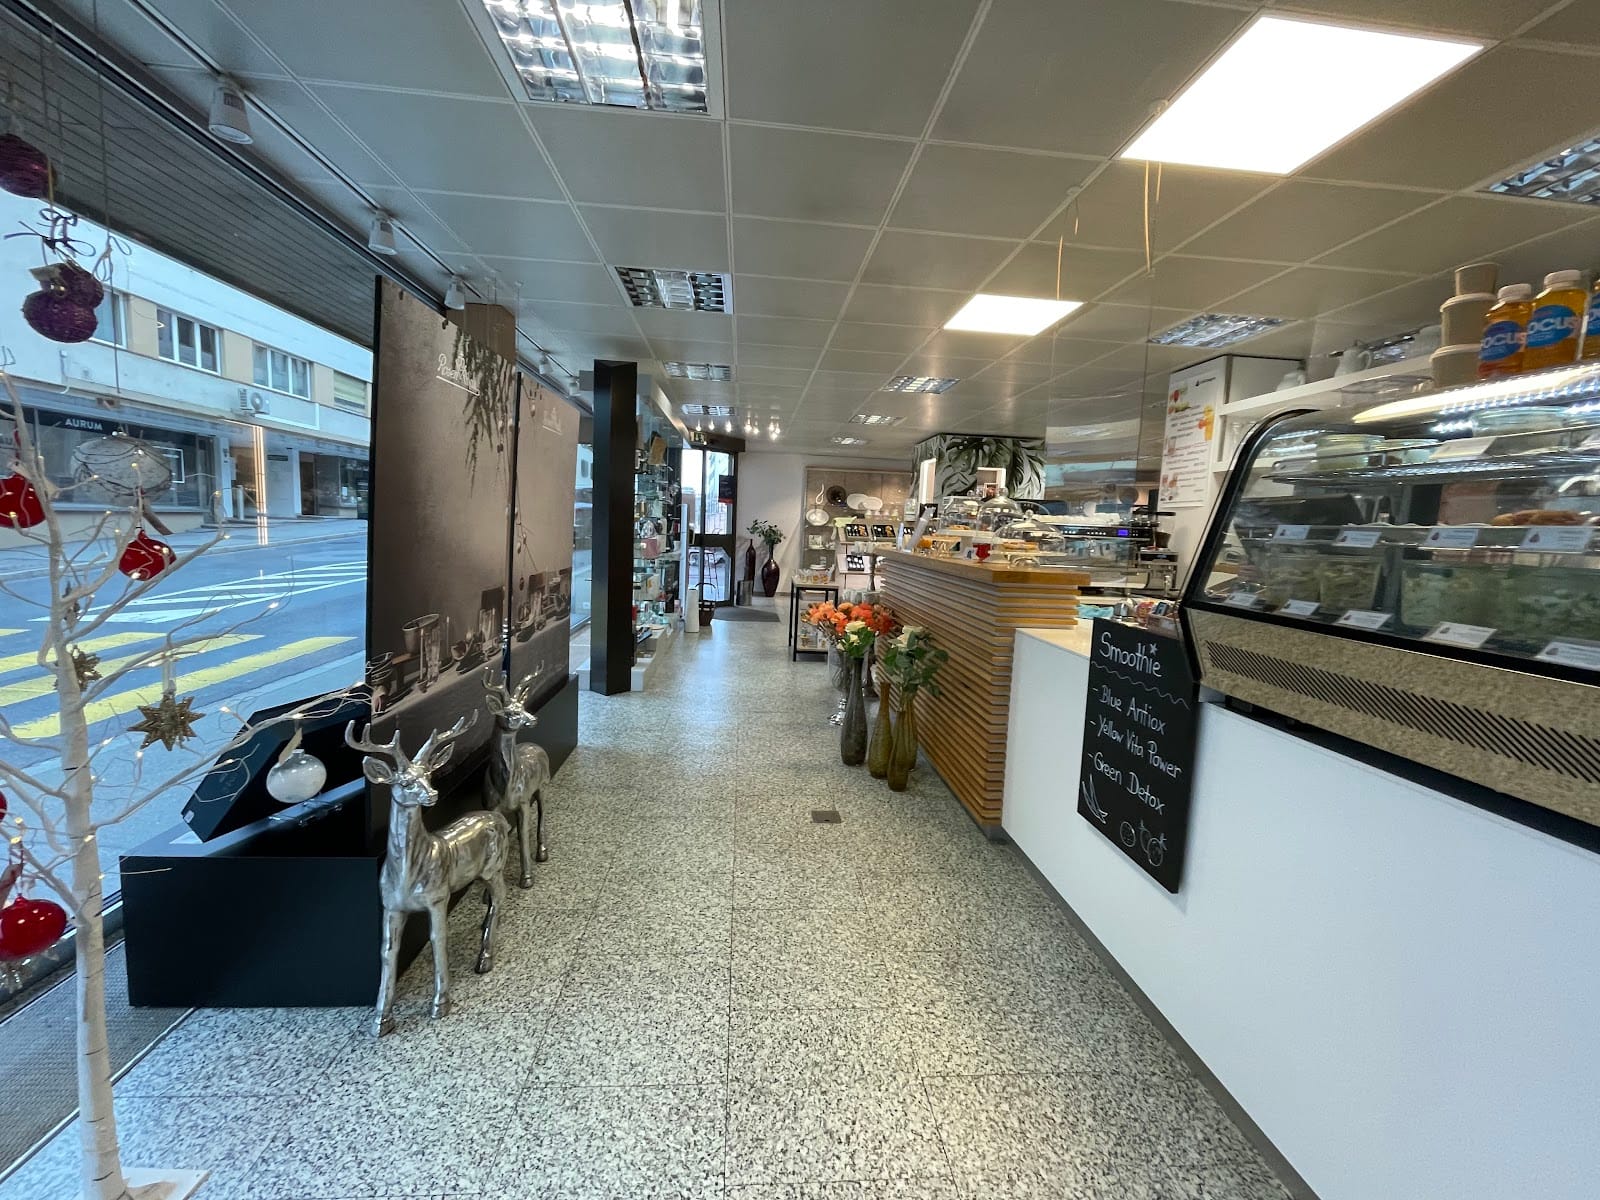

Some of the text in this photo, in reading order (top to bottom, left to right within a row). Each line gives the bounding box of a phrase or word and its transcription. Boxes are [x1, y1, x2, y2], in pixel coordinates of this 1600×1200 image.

[1527, 314, 1582, 334] OCUS
[64, 417, 103, 431] AURUM
[1100, 631, 1162, 677] Smoothie
[1100, 684, 1166, 735] Blue Antiox
[1097, 714, 1182, 779] Yellow Vita Power
[1093, 751, 1164, 815] Green Detox
